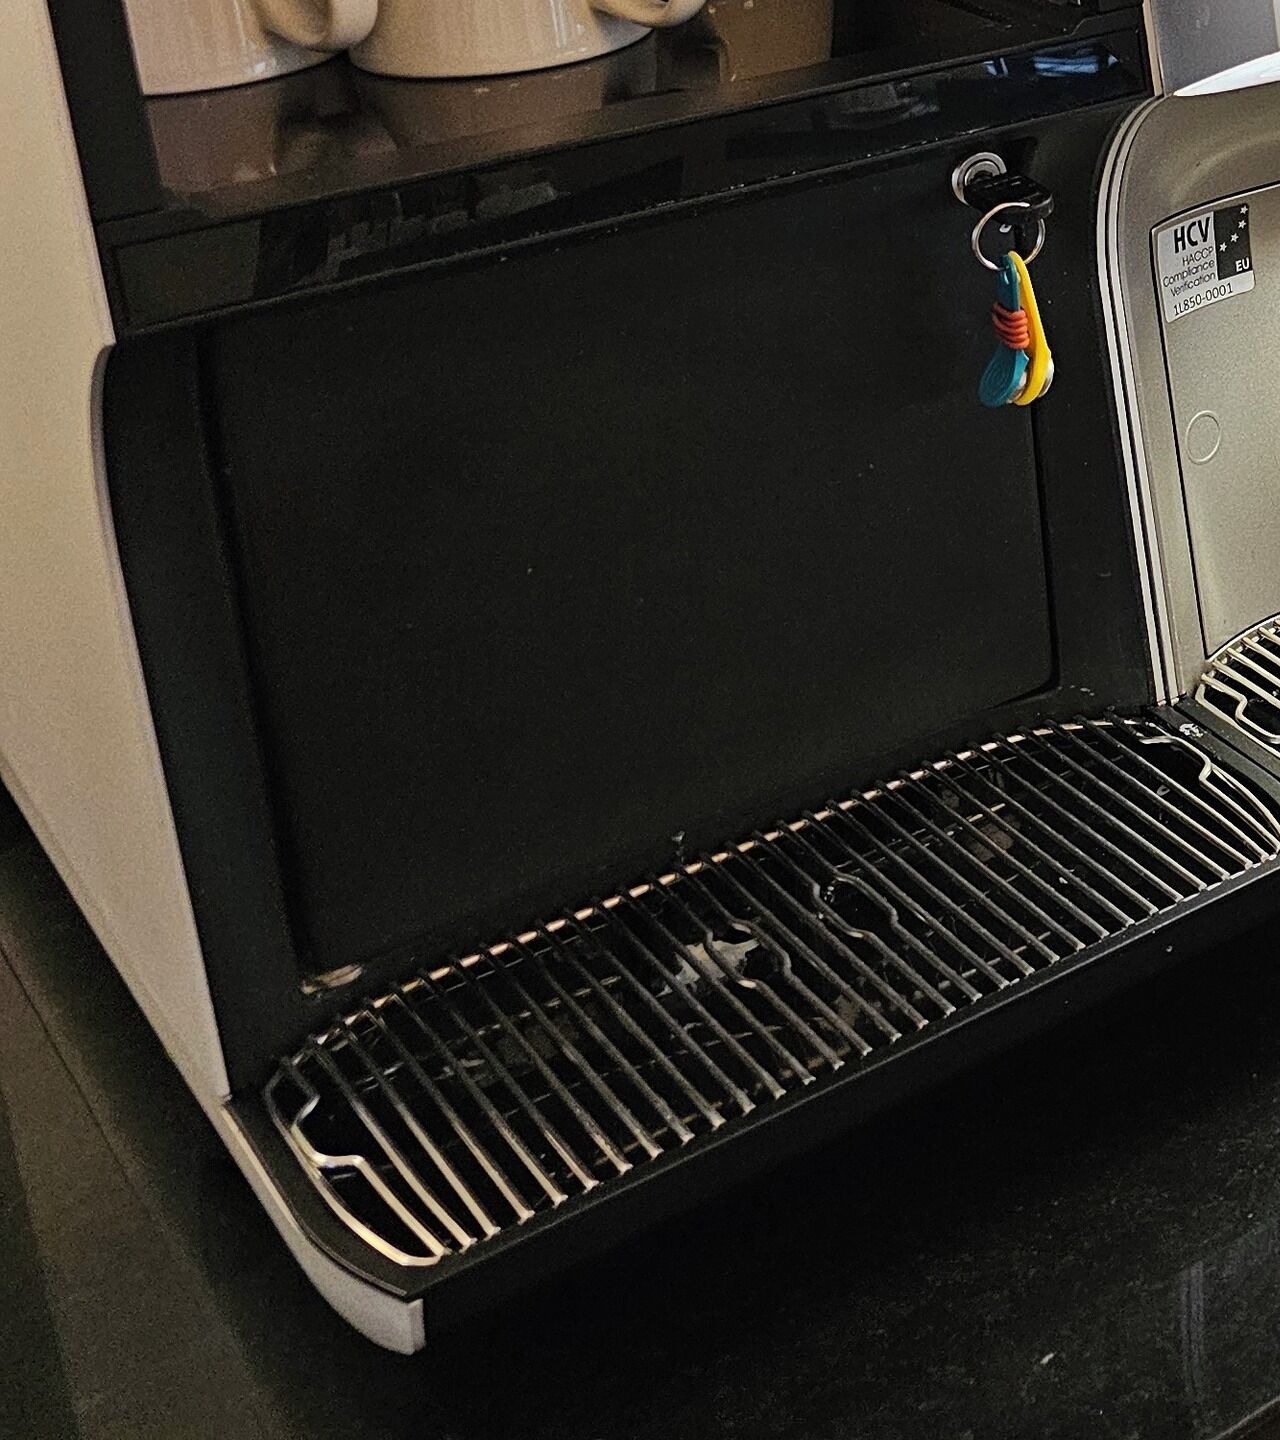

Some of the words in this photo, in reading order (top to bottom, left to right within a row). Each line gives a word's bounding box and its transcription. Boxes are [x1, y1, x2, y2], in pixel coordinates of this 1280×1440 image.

[1173, 216, 1211, 254] HCV
[1182, 246, 1214, 267] HACCP
[1235, 257, 1250, 273] EU
[1162, 259, 1215, 288] Compliance
[1170, 272, 1216, 297] Verification
